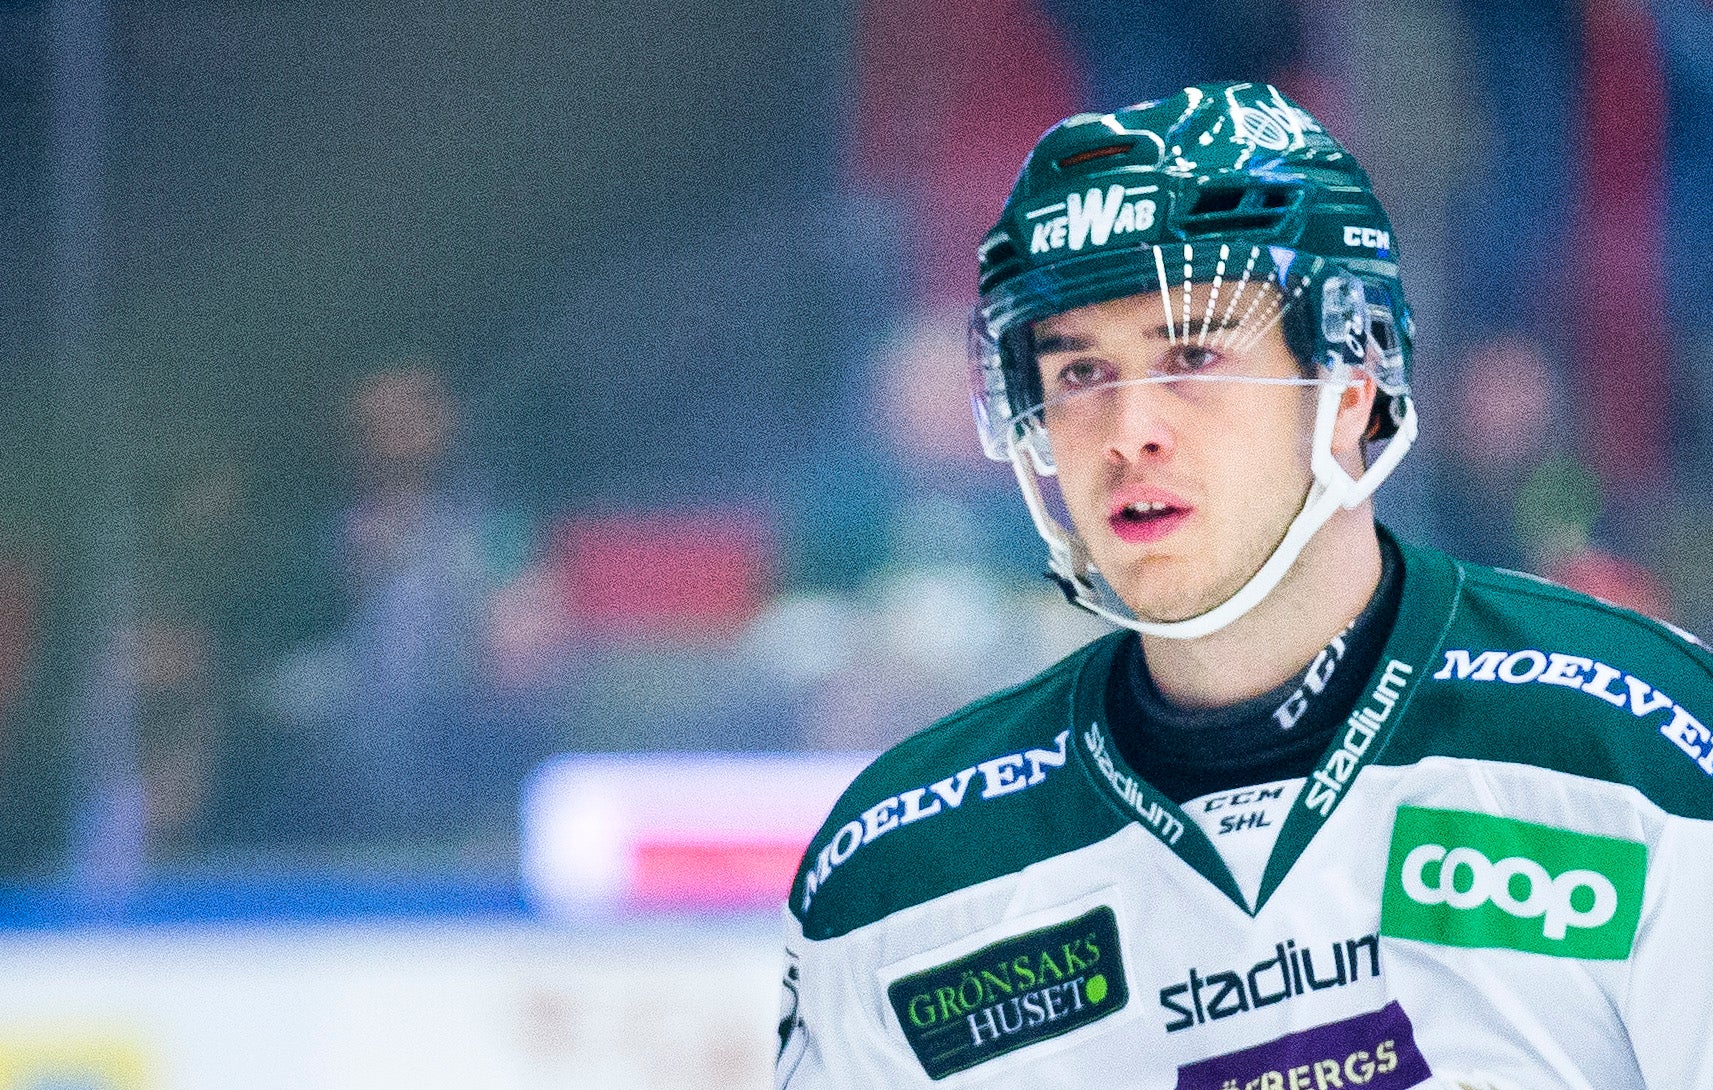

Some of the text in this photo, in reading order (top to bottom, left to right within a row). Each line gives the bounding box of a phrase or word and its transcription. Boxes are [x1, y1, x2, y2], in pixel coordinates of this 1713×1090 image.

[1343, 226, 1390, 250] CCM
[1083, 721, 1184, 845] stadium
[1305, 659, 1413, 817] stadium
[803, 730, 1070, 912] MOELVEN
[1204, 786, 1285, 812] CCM
[1218, 810, 1273, 835] SHL
[1401, 843, 1617, 941] coop
[907, 932, 1101, 1028] GRÖNSAKS
[966, 976, 1085, 1046] HUSET
